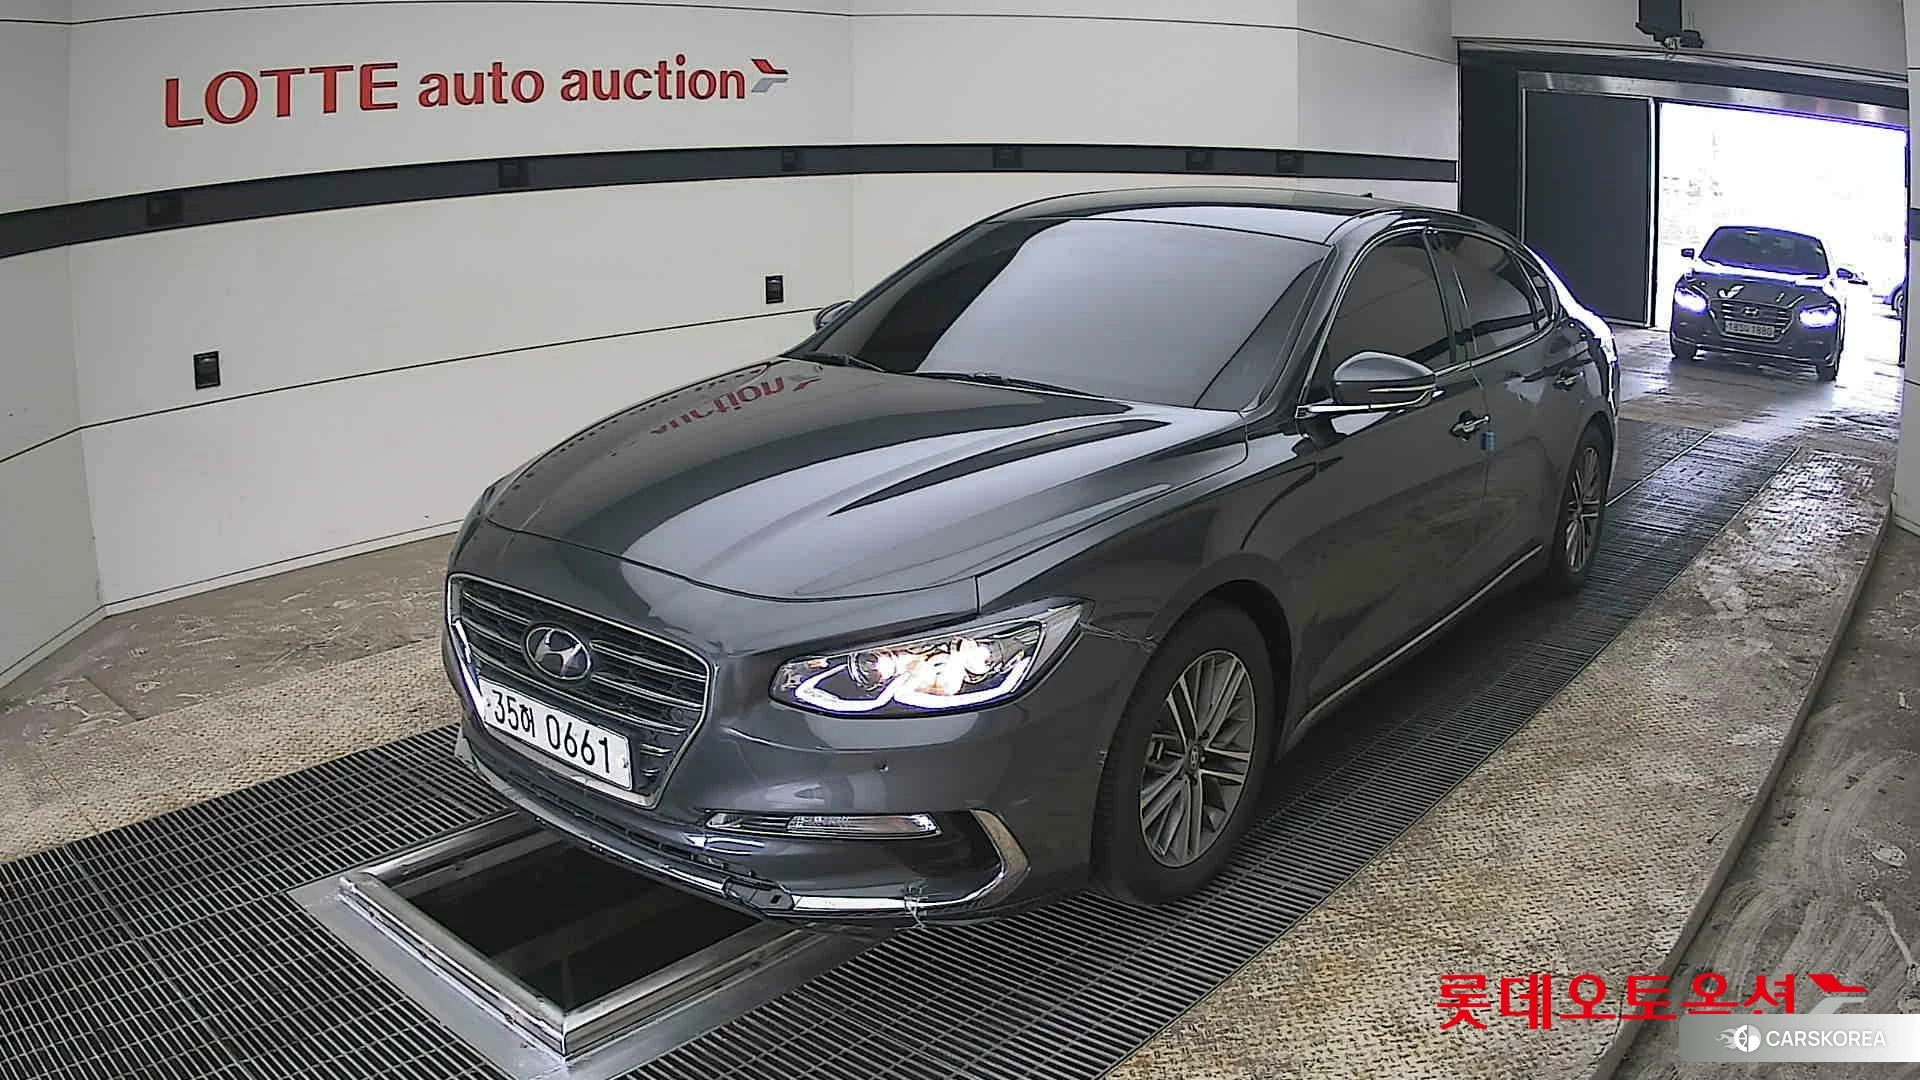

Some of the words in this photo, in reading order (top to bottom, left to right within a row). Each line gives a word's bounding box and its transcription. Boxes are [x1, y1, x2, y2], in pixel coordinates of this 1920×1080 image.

[164, 62, 399, 128] LOTTE
[418, 62, 545, 107] auto
[560, 54, 746, 101] auction
[492, 689, 536, 738] 35허
[546, 714, 610, 774] 0661
